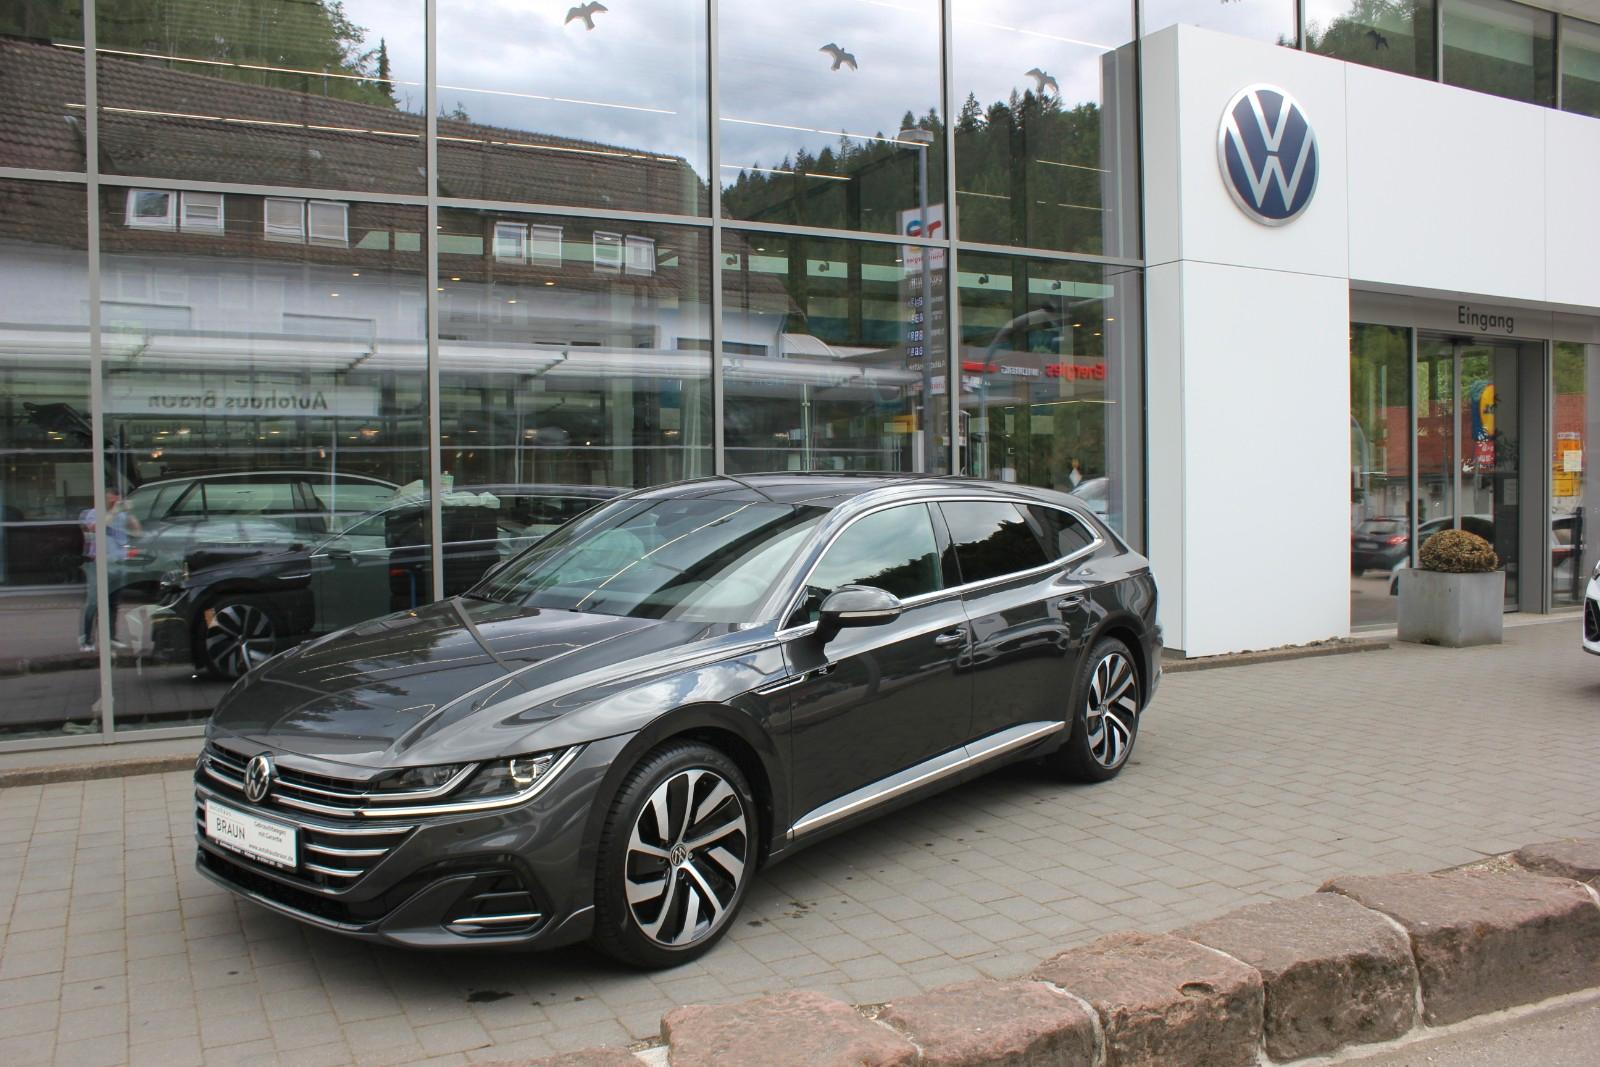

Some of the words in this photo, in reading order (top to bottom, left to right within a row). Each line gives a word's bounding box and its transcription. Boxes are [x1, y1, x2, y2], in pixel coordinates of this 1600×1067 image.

[1222, 85, 1317, 222] VW
[1457, 305, 1515, 334] Eingang
[216, 818, 245, 839] BRAUN
